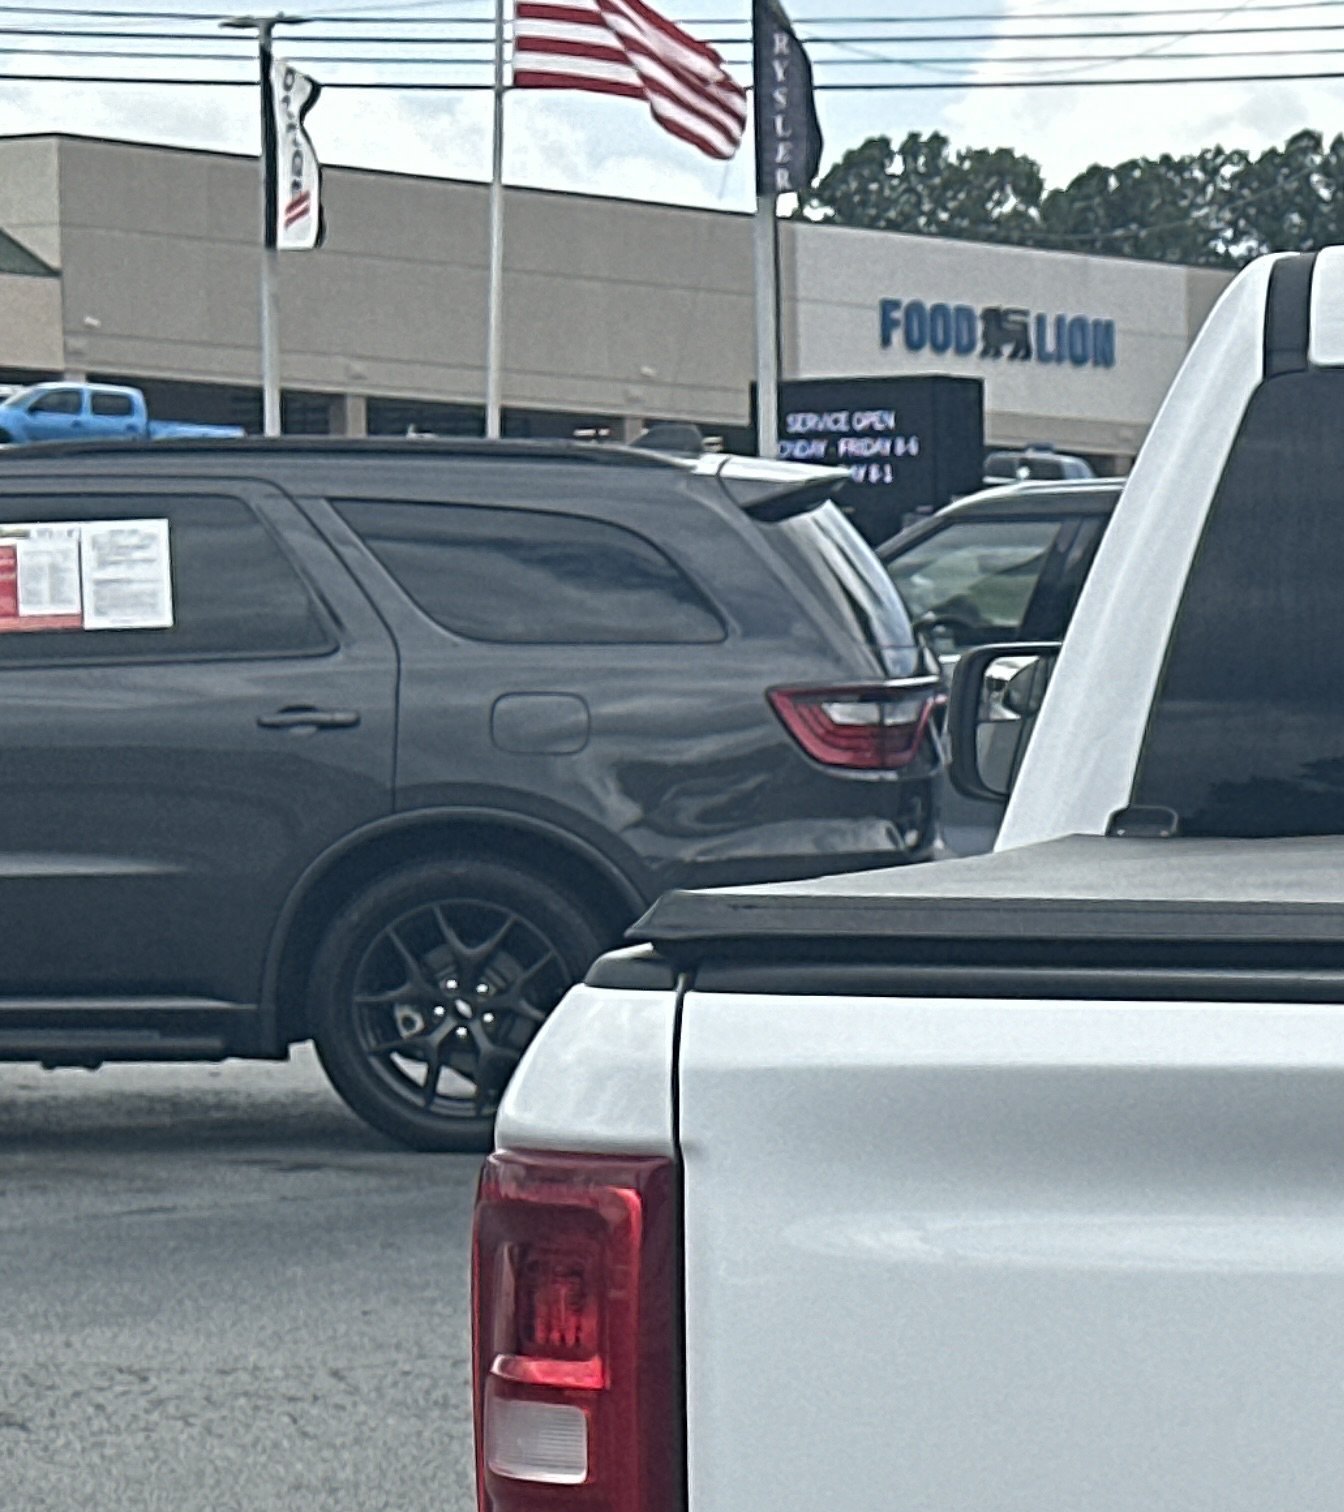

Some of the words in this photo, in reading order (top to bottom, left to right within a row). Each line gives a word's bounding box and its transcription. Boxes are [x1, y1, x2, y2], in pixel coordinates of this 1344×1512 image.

[772, 31, 794, 191] RYSLER
[879, 298, 978, 358] FOOD
[1035, 312, 1115, 369] LION
[786, 411, 849, 432] SERVICE
[852, 410, 896, 431] OPEN
[778, 439, 828, 459] ONDAY
[838, 436, 892, 457] FRIDAY
